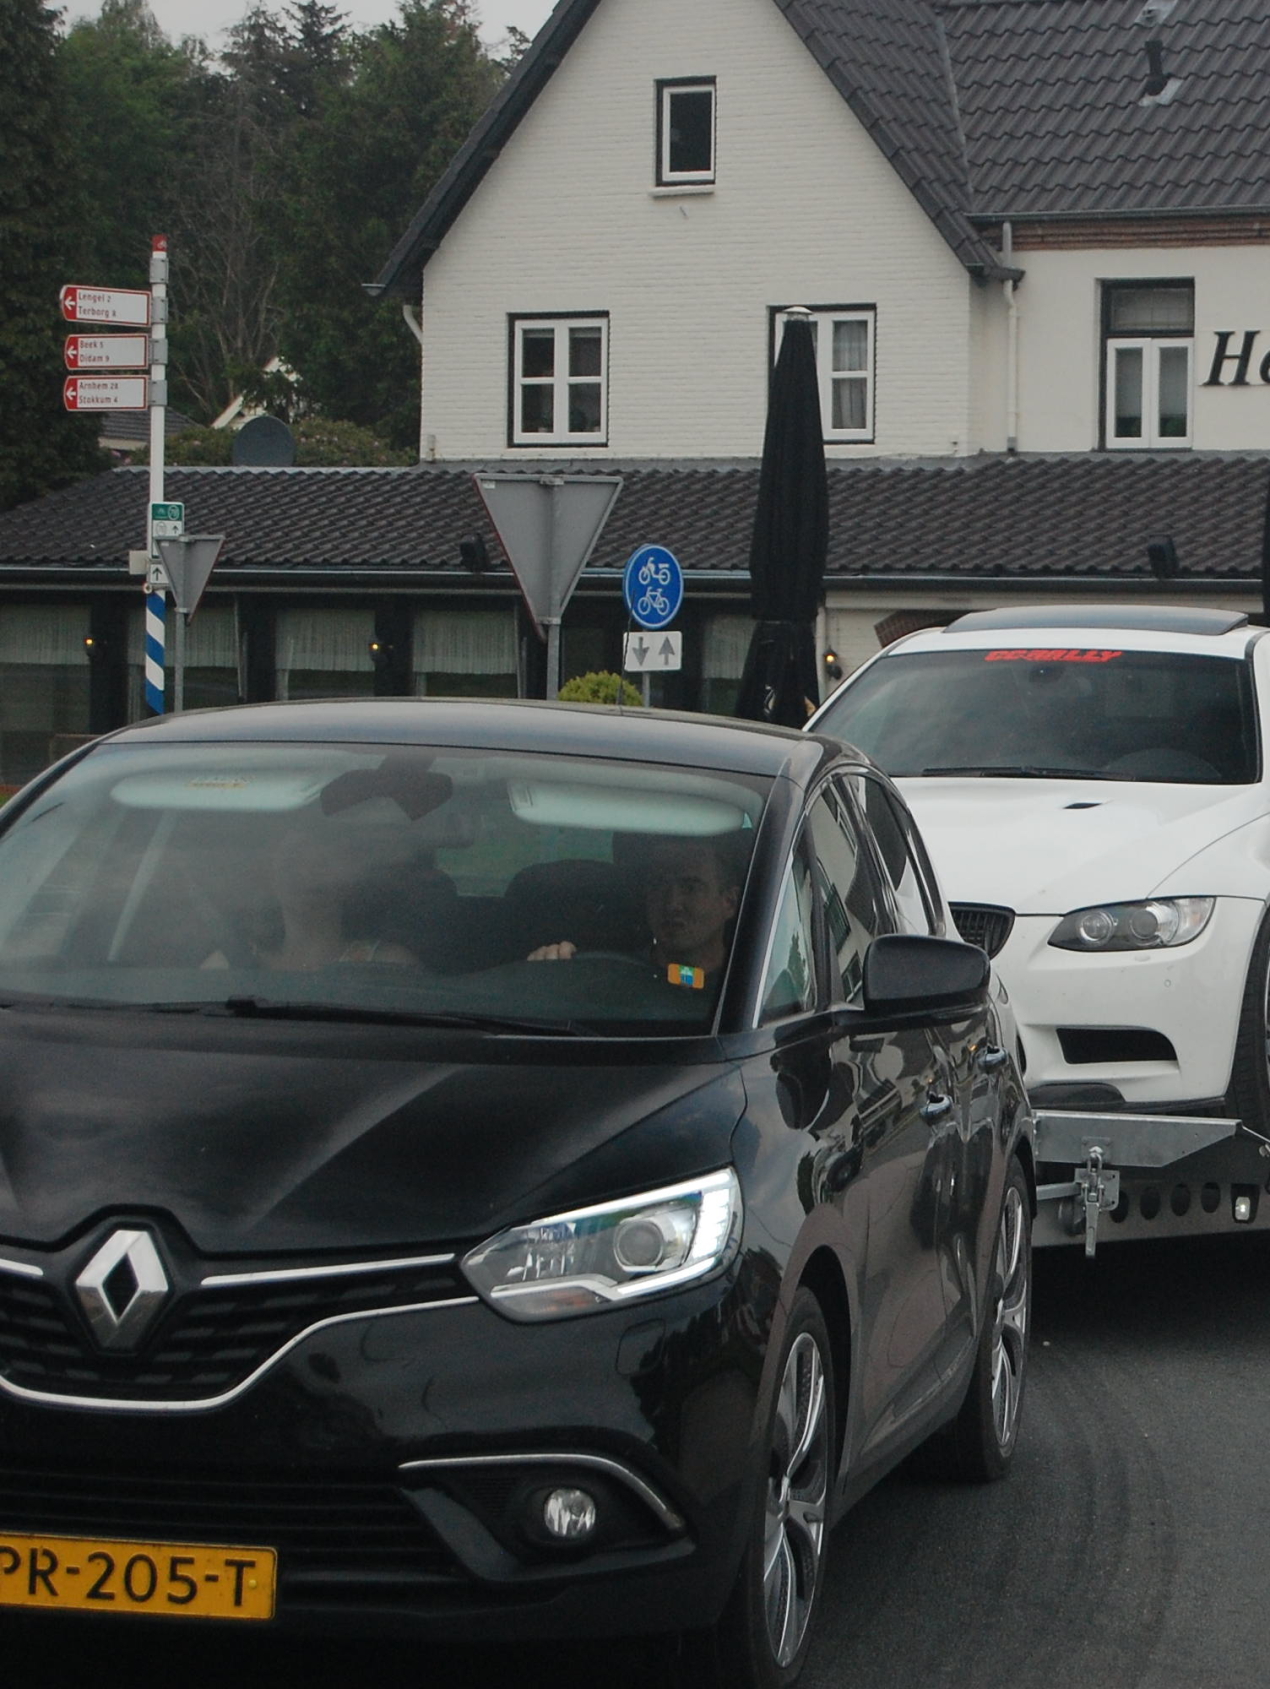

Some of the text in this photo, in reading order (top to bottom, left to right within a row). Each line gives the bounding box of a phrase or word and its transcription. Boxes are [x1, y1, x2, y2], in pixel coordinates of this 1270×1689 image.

[78, 291, 105, 303] Lengel
[78, 306, 110, 318] Terborg
[79, 355, 103, 363] Didam
[79, 382, 109, 390] Arnhem
[79, 396, 111, 405] Stokkum
[0, 1545, 256, 1607] PR-205-T
